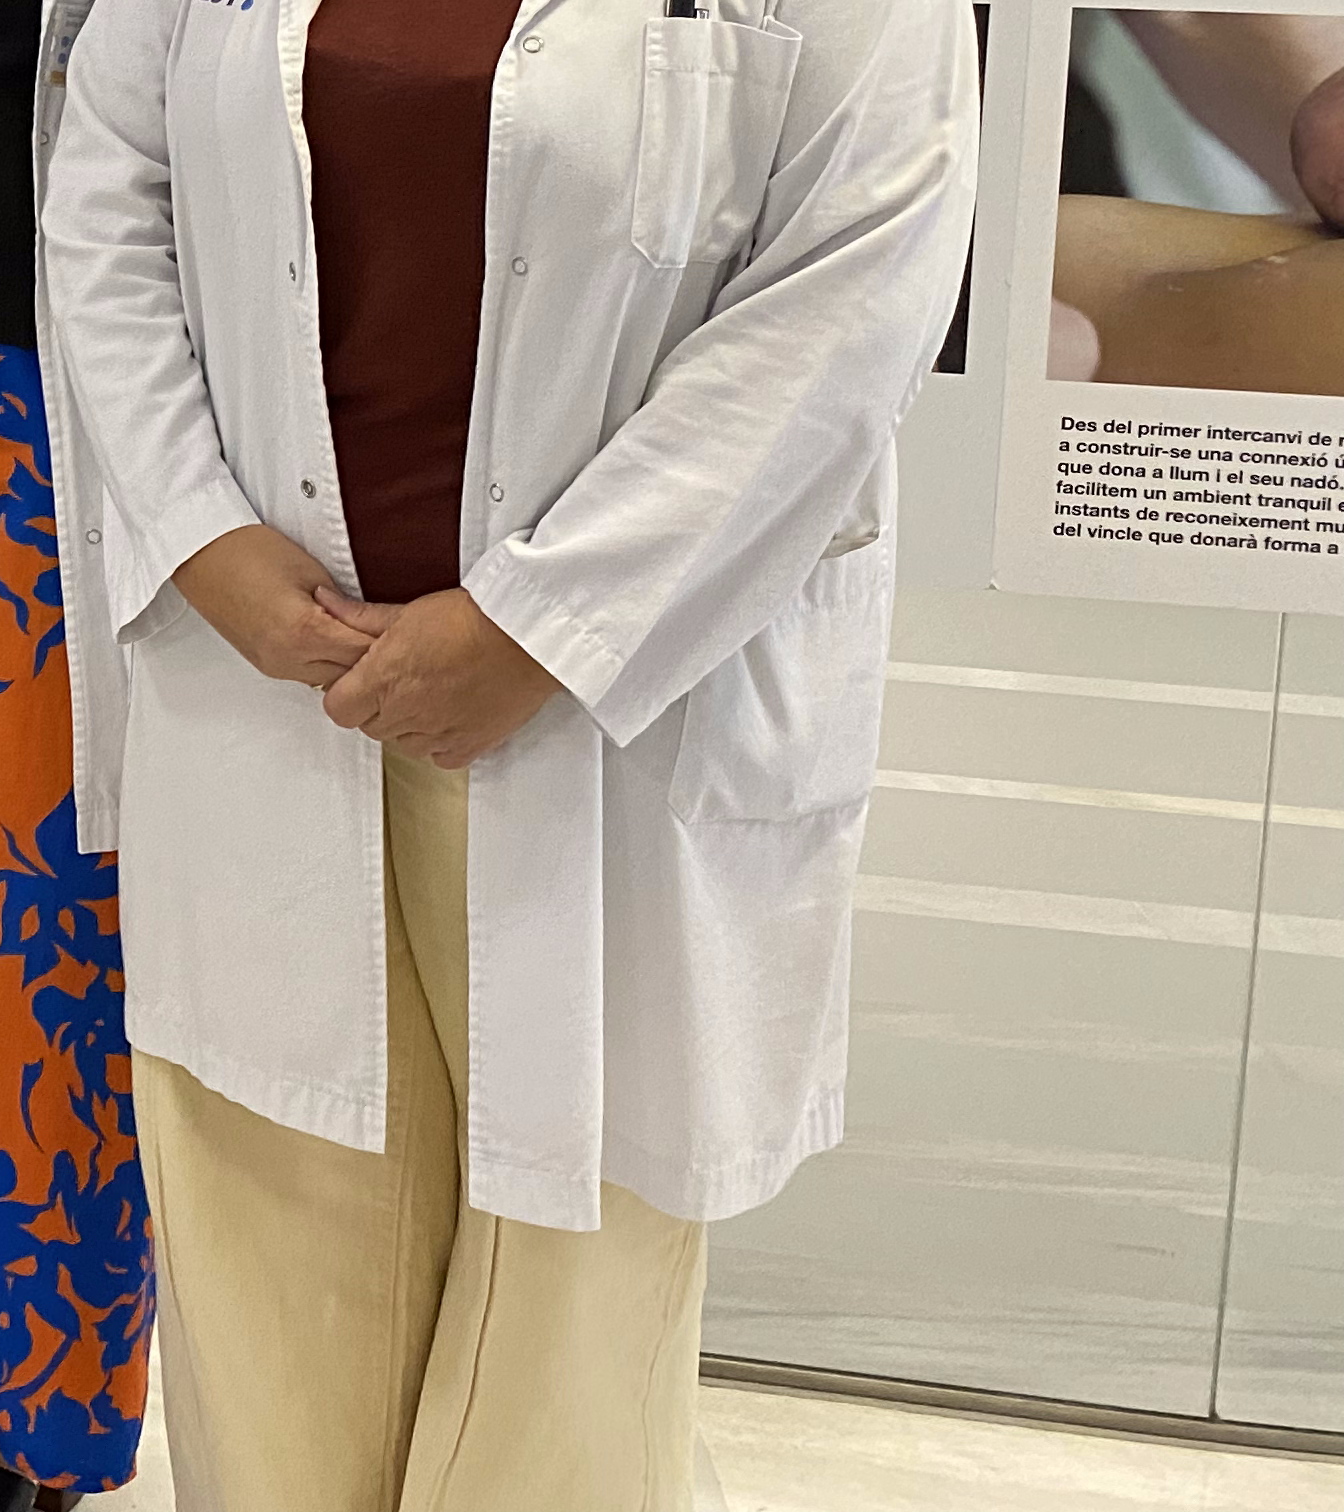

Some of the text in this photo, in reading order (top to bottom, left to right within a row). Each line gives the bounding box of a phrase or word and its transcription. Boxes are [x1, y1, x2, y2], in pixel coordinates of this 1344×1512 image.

[1061, 416, 1097, 432] Des
[1103, 419, 1132, 434] del
[1138, 422, 1202, 438] primer
[1207, 425, 1302, 444] intercanvi
[1308, 432, 1332, 446] de
[1059, 441, 1328, 467] a construir-se una connexió
[1058, 462, 1344, 490] que dona a llum i el seu nadó.
[1056, 480, 1331, 512] facilitem un ambient tranquil
[1055, 501, 1130, 519] instants
[1136, 507, 1159, 521] de
[1166, 512, 1310, 531] reconeixement
[1053, 522, 1338, 554] del vincle que donarà forma a
